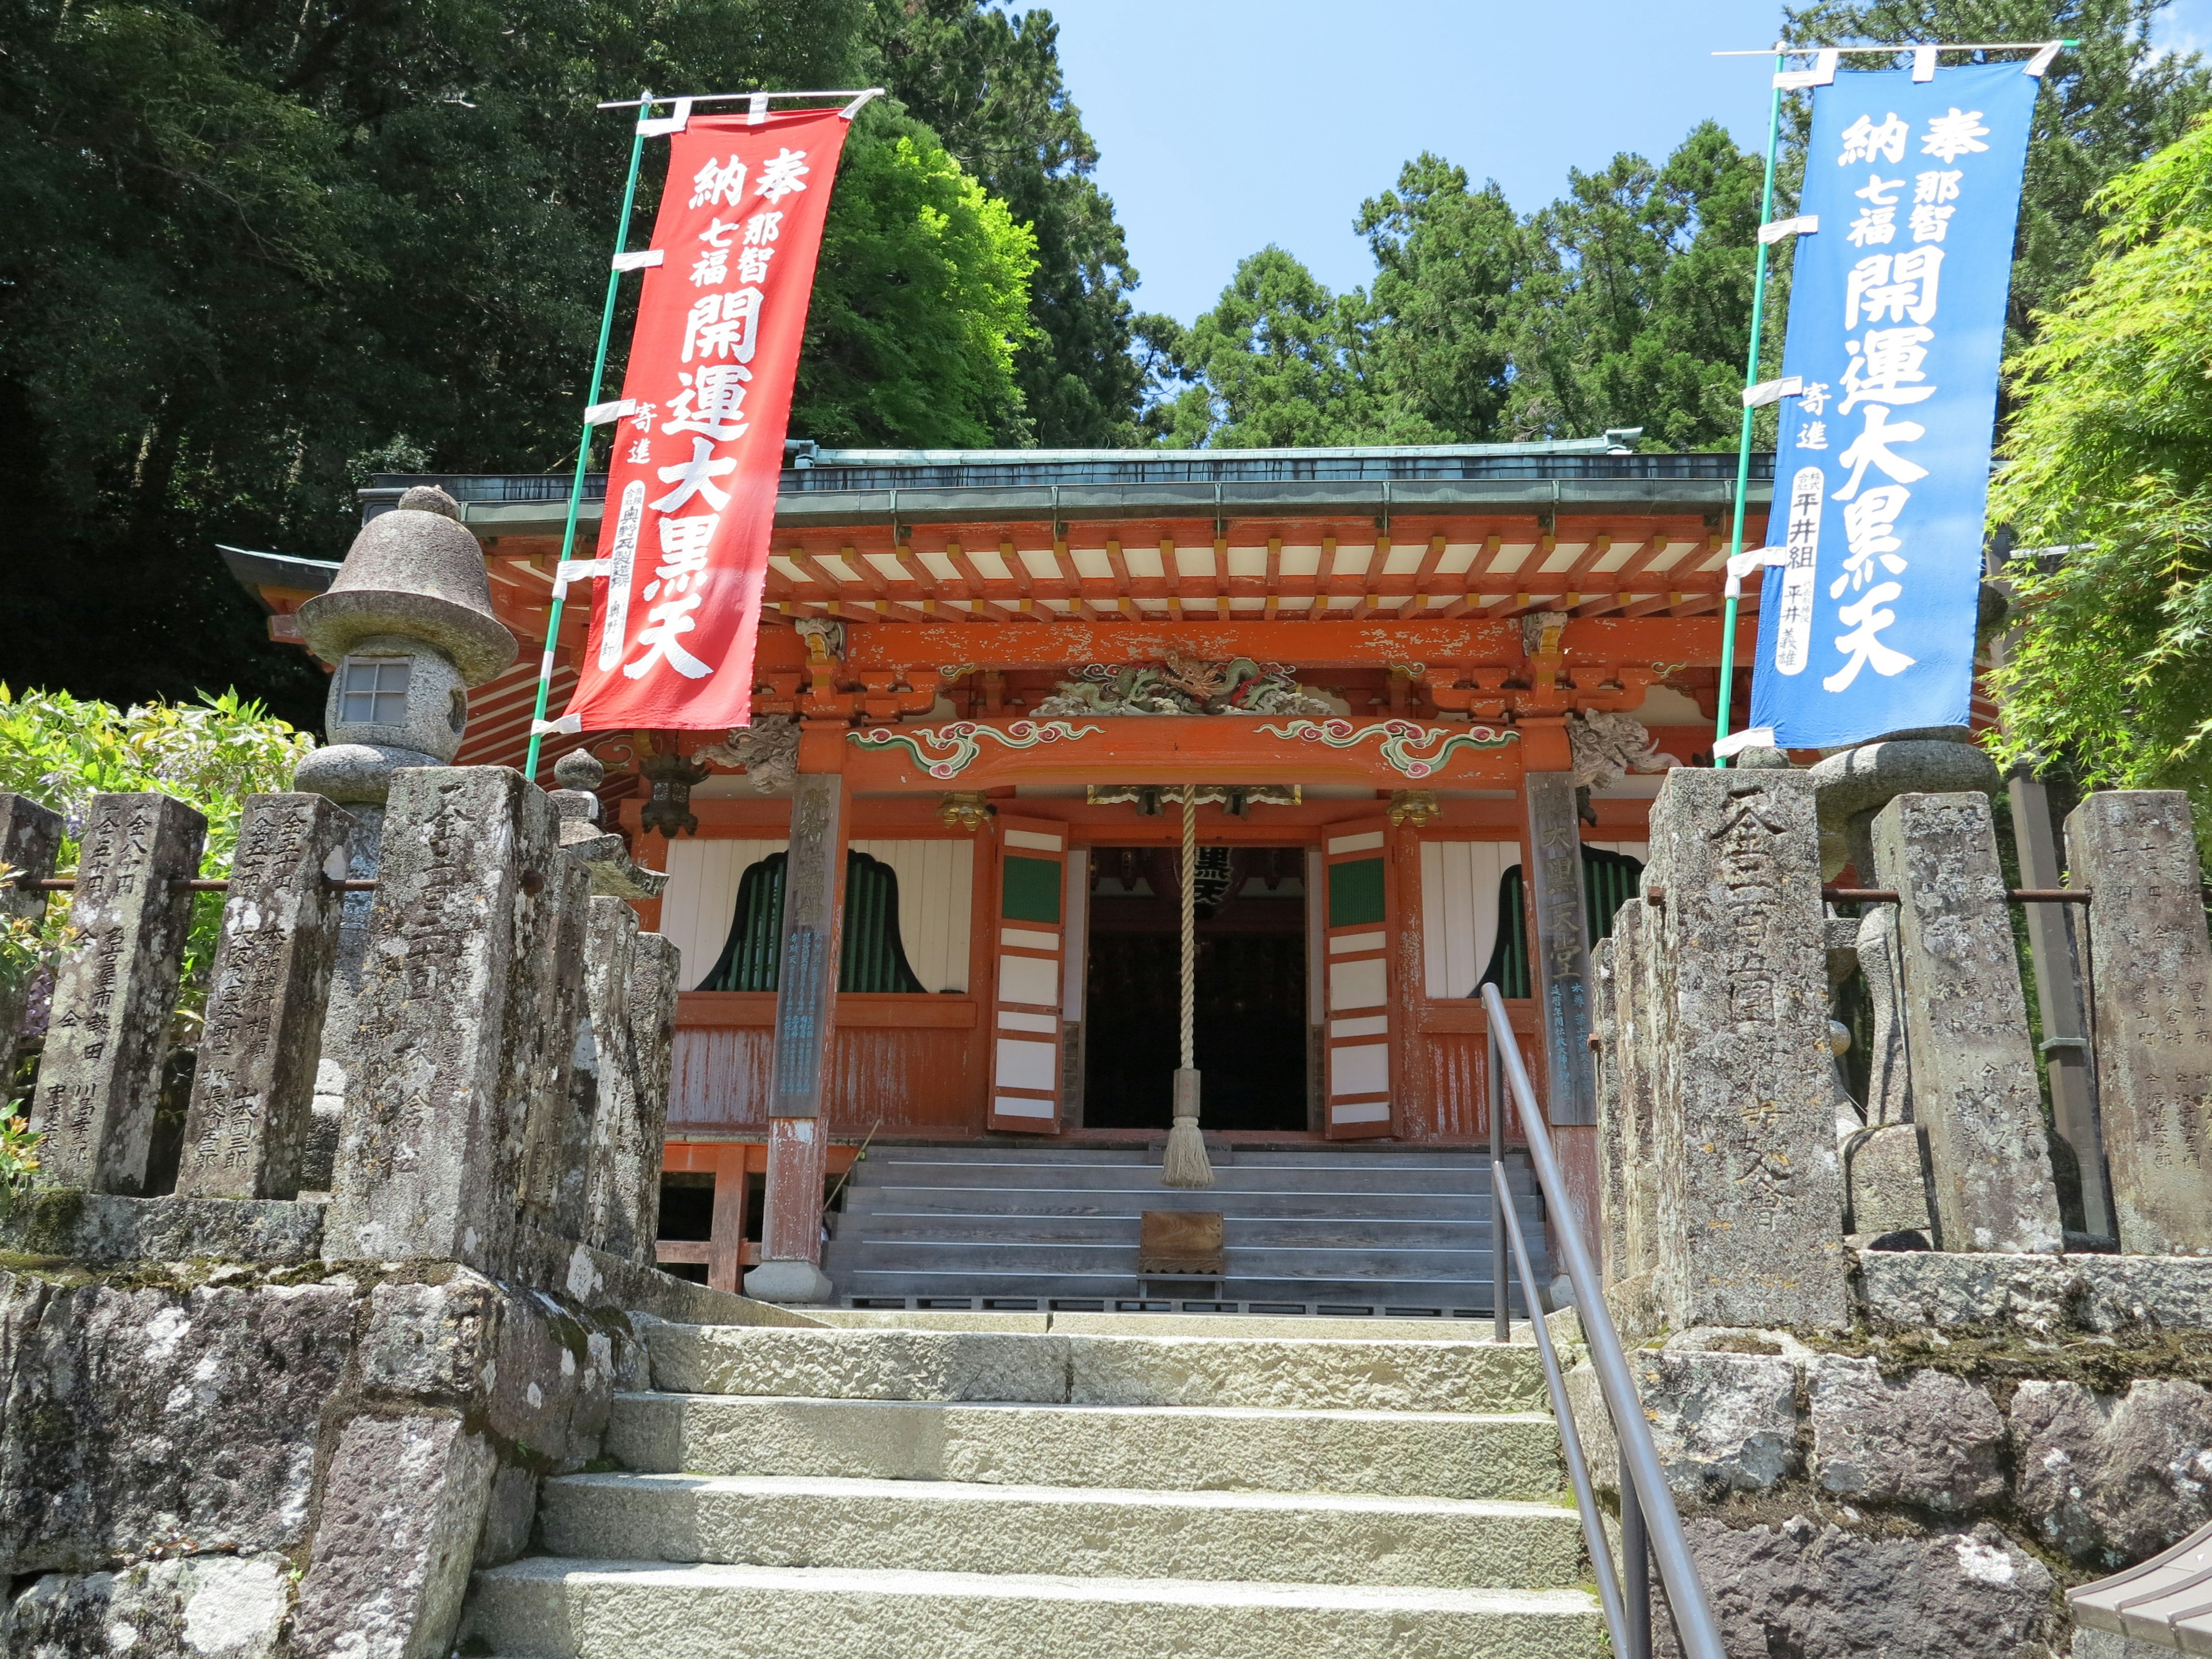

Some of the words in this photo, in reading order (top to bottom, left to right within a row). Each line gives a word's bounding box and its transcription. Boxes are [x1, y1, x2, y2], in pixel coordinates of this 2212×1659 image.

[1838, 107, 1991, 166] 奉納
[688, 147, 810, 209] 奉納
[1846, 174, 1906, 247] 七福
[1908, 169, 1964, 243] 那智
[689, 217, 740, 287] 七福
[736, 211, 784, 285] 那智
[627, 402, 658, 464] 寄進
[1797, 382, 1832, 450] 寄進
[623, 286, 764, 680] 開運大黒天
[1822, 244, 1945, 693] 開運大黒天
[1786, 493, 1820, 570] 平井組
[1542, 823, 1582, 979] 大黒天堂
